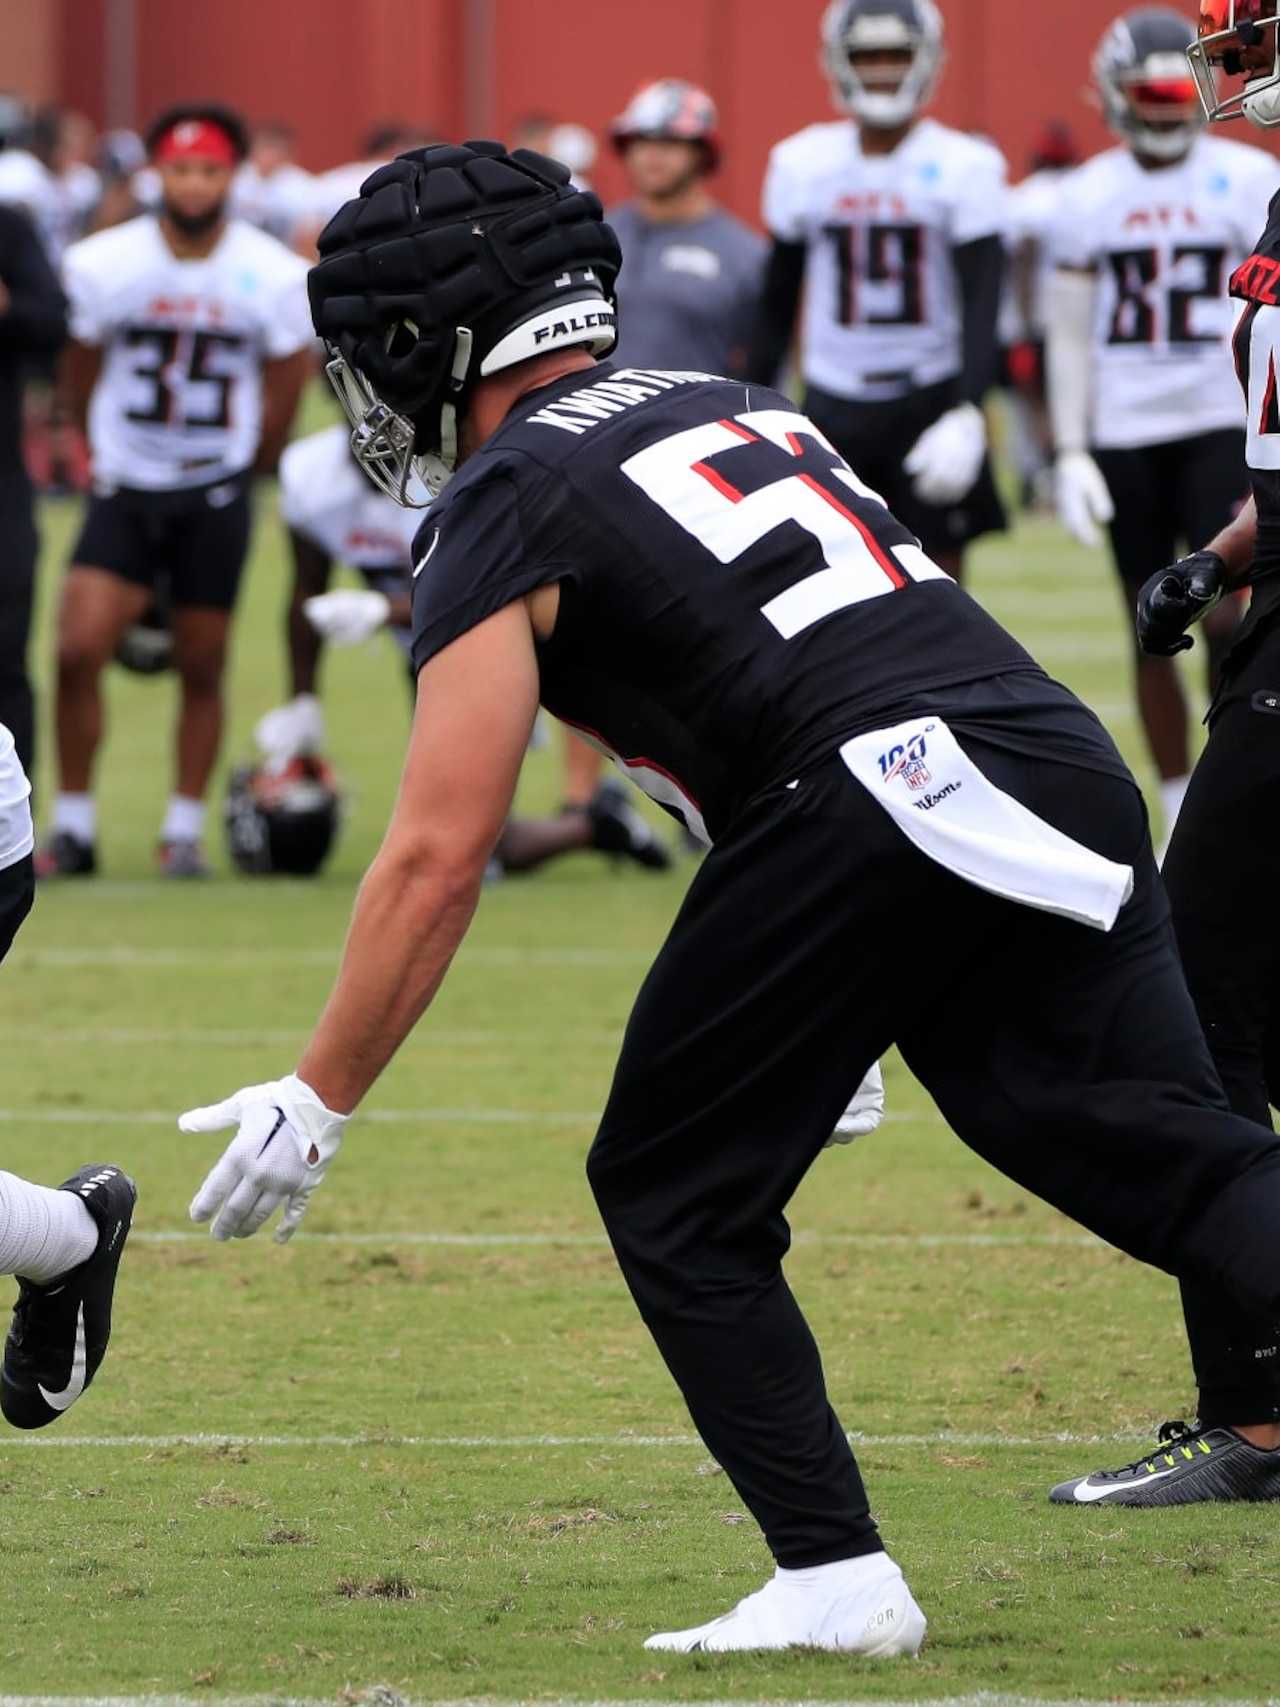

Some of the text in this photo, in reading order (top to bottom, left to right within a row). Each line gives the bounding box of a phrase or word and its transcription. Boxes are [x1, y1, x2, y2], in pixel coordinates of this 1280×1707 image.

[822, 223, 927, 327] 19
[1109, 246, 1226, 345] 82
[1230, 254, 1280, 305] ATL
[533, 312, 618, 345] FALCO
[124, 327, 244, 430] 35
[620, 410, 956, 640] 53
[878, 734, 927, 776] 100
[908, 771, 929, 789] NFL
